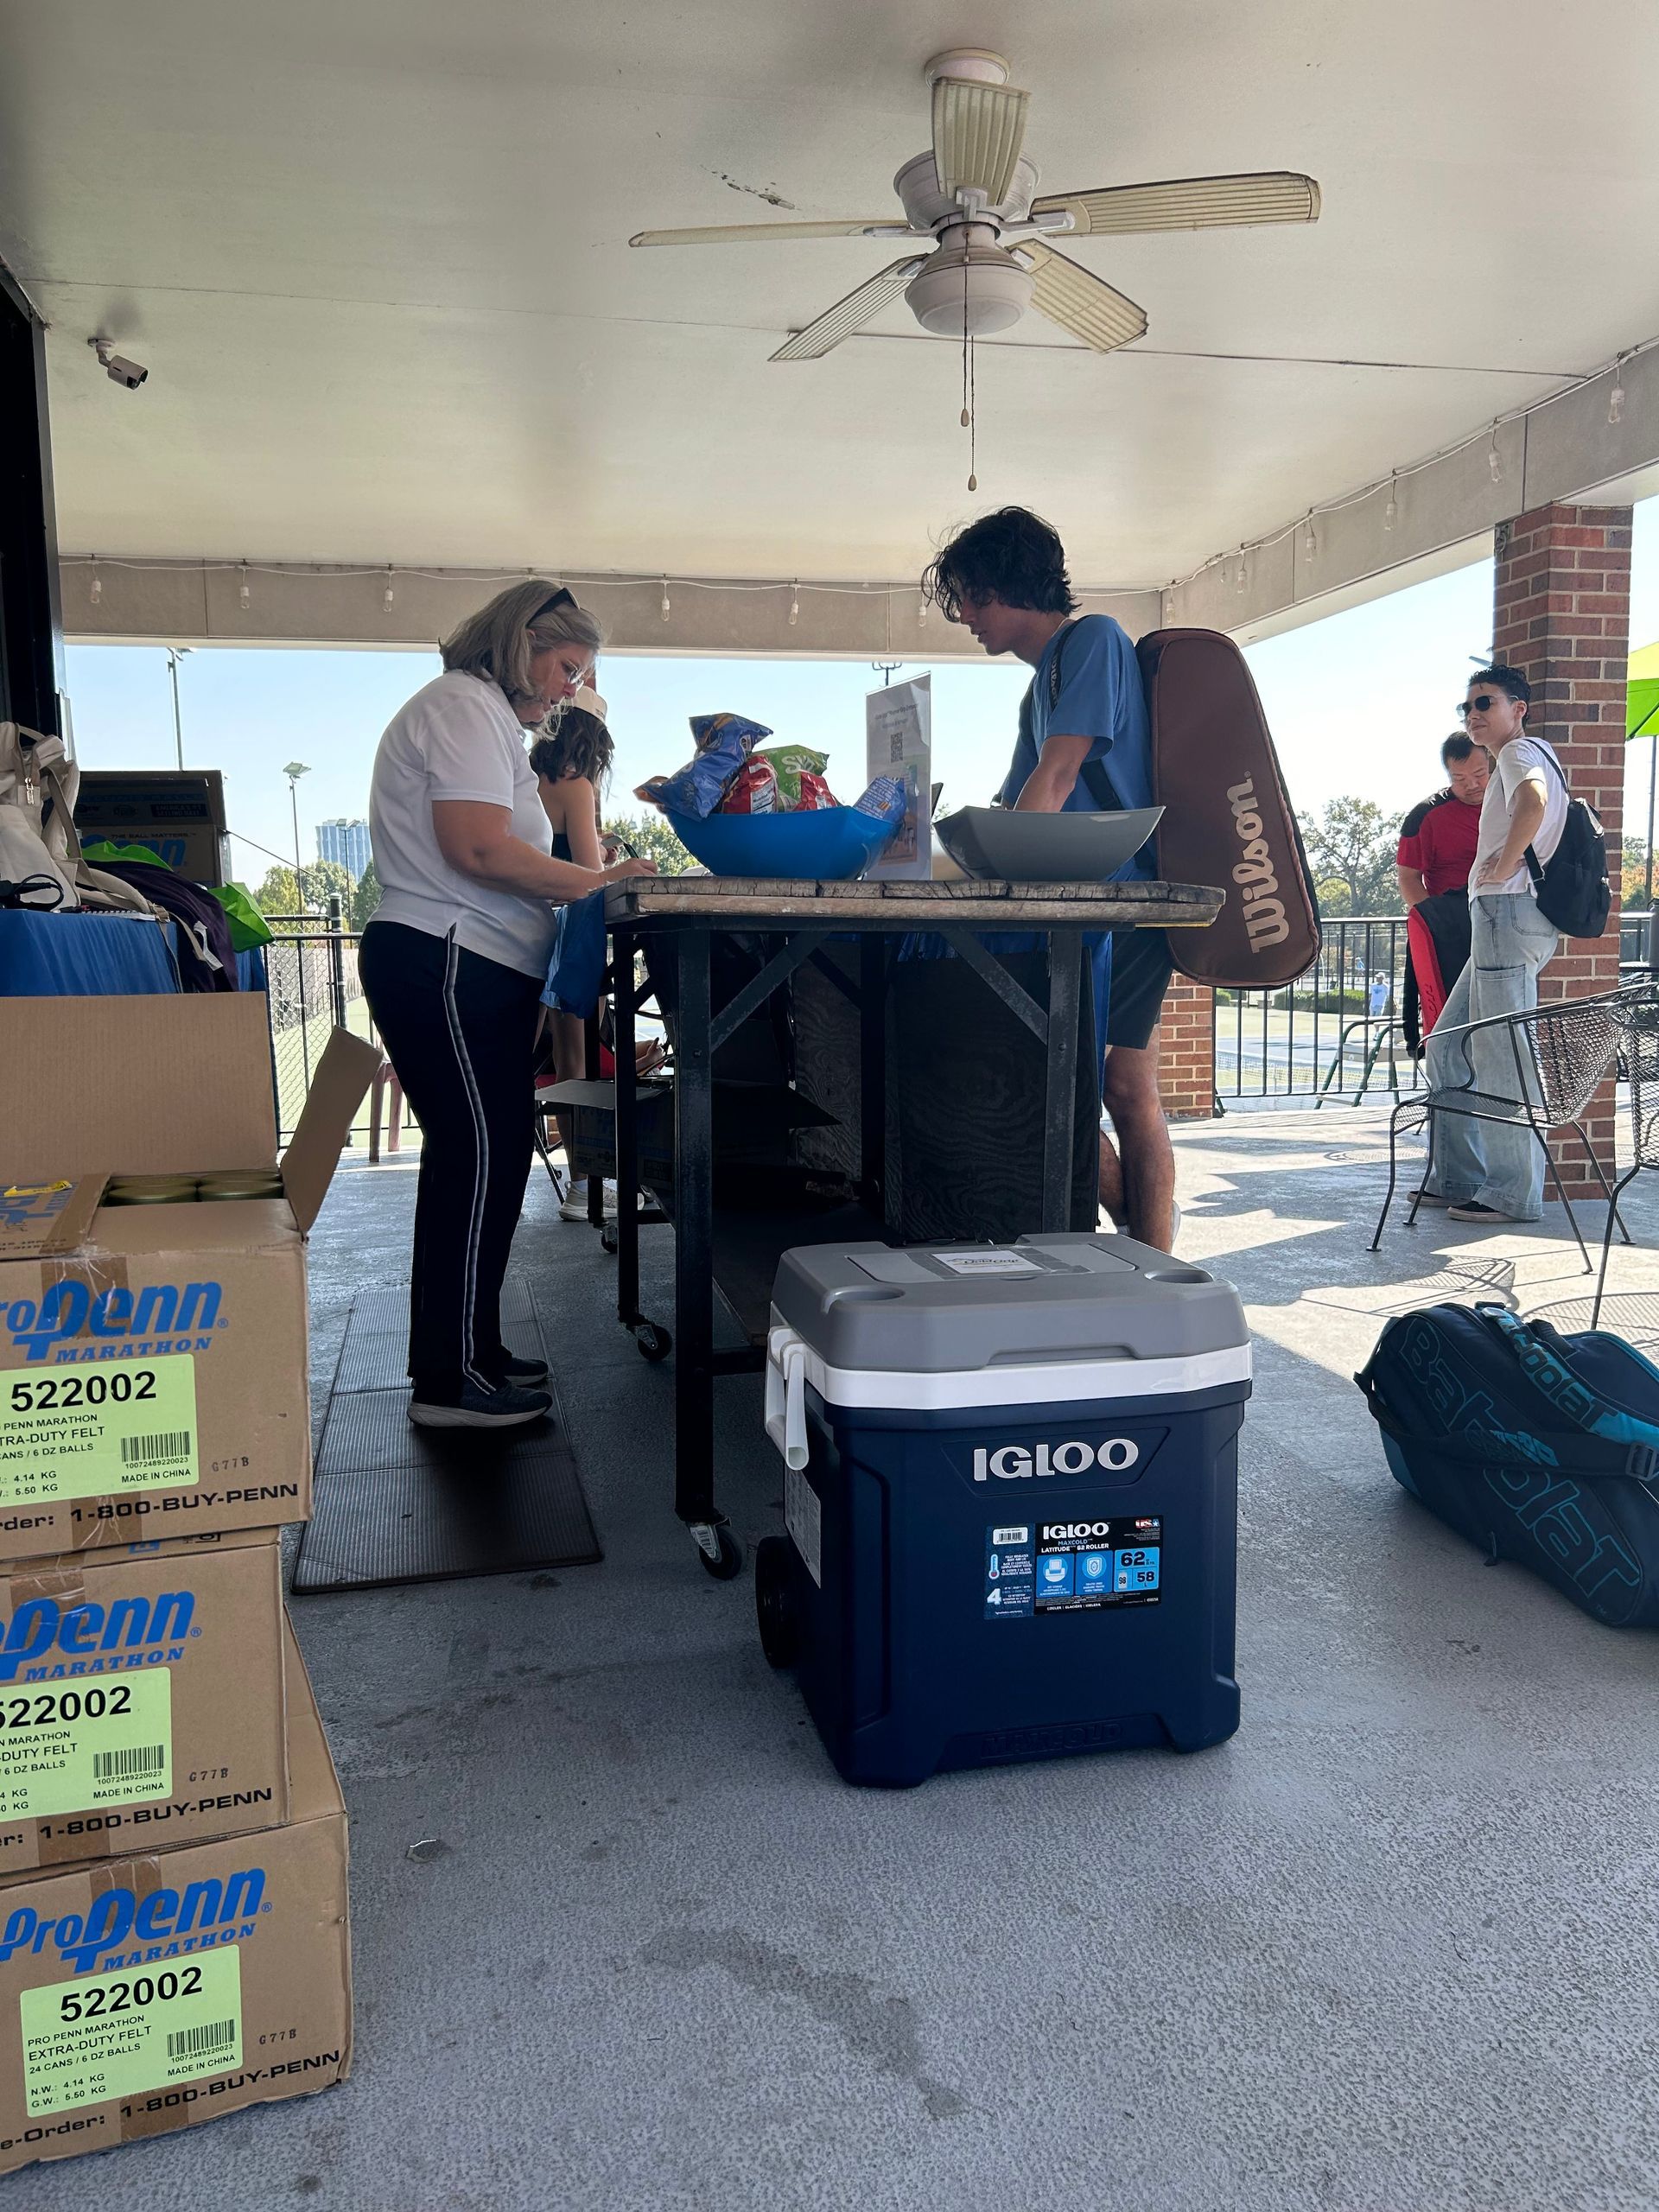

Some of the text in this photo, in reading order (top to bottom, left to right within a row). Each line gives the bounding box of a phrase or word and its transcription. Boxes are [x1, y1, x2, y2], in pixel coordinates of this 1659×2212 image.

[1226, 777, 1291, 954] Wilson
[54, 1337, 213, 1363] MARATHON
[11, 1370, 157, 1412] 522002
[4, 1421, 33, 1430] PENN
[36, 1414, 98, 1427] MARATHON
[72, 1427, 105, 1439] FELT
[0, 1451, 23, 1460] ANS
[60, 1443, 94, 1454] BALLS
[974, 1438, 1139, 1482] IGLOO
[125, 1457, 188, 1470] 10072489220023
[41, 1471, 57, 1479] KG
[121, 1473, 149, 1484] MADE
[162, 1469, 191, 1478] CHINA
[16, 1486, 35, 1495] 5.50
[42, 1484, 58, 1492] KG
[71, 1484, 298, 1522] 1-800-BUY-PENN
[0, 1516, 54, 1530] der:
[1043, 1522, 1109, 1540] IGLOO
[1120, 1551, 1146, 1567] 62
[1136, 1571, 1155, 1583] 58
[987, 1587, 1001, 1605] 4
[0, 1591, 195, 1681] Penn
[24, 1647, 185, 1682] MARATHON
[0, 1686, 131, 1728] 22002
[9, 1731, 71, 1745] MARATHON
[44, 1743, 78, 1756] FELT
[14, 1765, 28, 1774] DZ
[31, 1760, 66, 1771] BALLS
[189, 1768, 229, 1782] G77B
[98, 1770, 162, 1785] 10072489220023
[12, 1789, 28, 1797] KG
[93, 1789, 121, 1799] MADE
[135, 1782, 165, 1792] CHINA
[13, 1802, 29, 1810] KG
[40, 1788, 272, 1839] 1-800-BUY-PENN
[102, 1923, 256, 1972] MARATHON
[60, 1967, 202, 2022] 522002
[28, 2015, 144, 2047] PRO PENN MARATHON
[259, 2029, 296, 2044] G77B
[29, 2025, 152, 2062] EXTRA-DUTY FELT
[29, 2066, 41, 2075] 24
[44, 2058, 73, 2071] CANS
[91, 2051, 105, 2061] DZ
[108, 2044, 141, 2056] BALLS
[171, 2044, 233, 2063] 10072489220023
[168, 2065, 194, 2076] MADE
[207, 2054, 235, 2067] CHINA
[31, 2073, 105, 2096] N.W.: 4.14 KG
[121, 2050, 340, 2118] 1-800-BUY-PENN
[31, 2085, 106, 2107] G.W.: 5.50 KG
